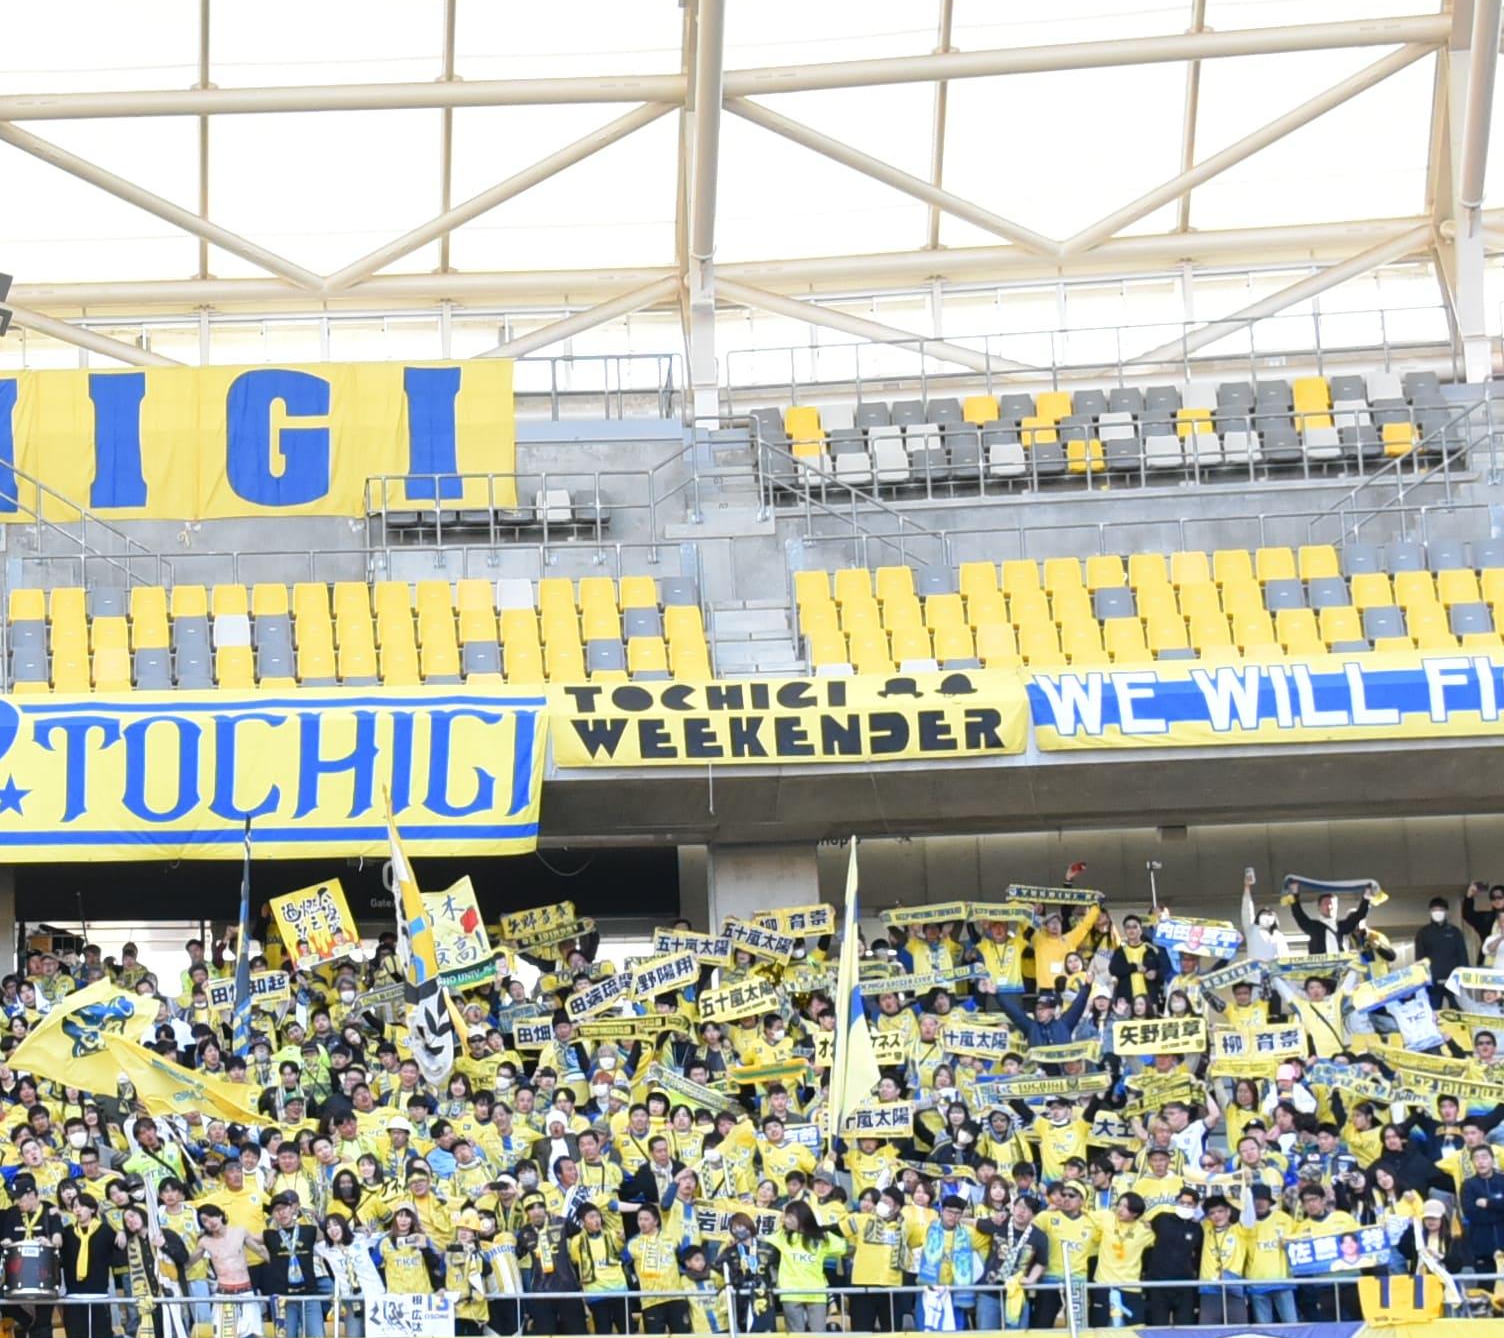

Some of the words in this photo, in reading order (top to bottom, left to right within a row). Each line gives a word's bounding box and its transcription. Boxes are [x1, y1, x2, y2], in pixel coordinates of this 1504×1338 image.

[563, 680, 849, 714] TOCHIGI
[1031, 671, 1158, 737] WE
[1189, 661, 1401, 732] WILL
[571, 709, 1009, 760] WEEKENDER
[31, 708, 536, 823] TOCHIGI
[656, 935, 729, 956] 五十嵐太陽
[722, 922, 793, 955] 五十嵐太陽
